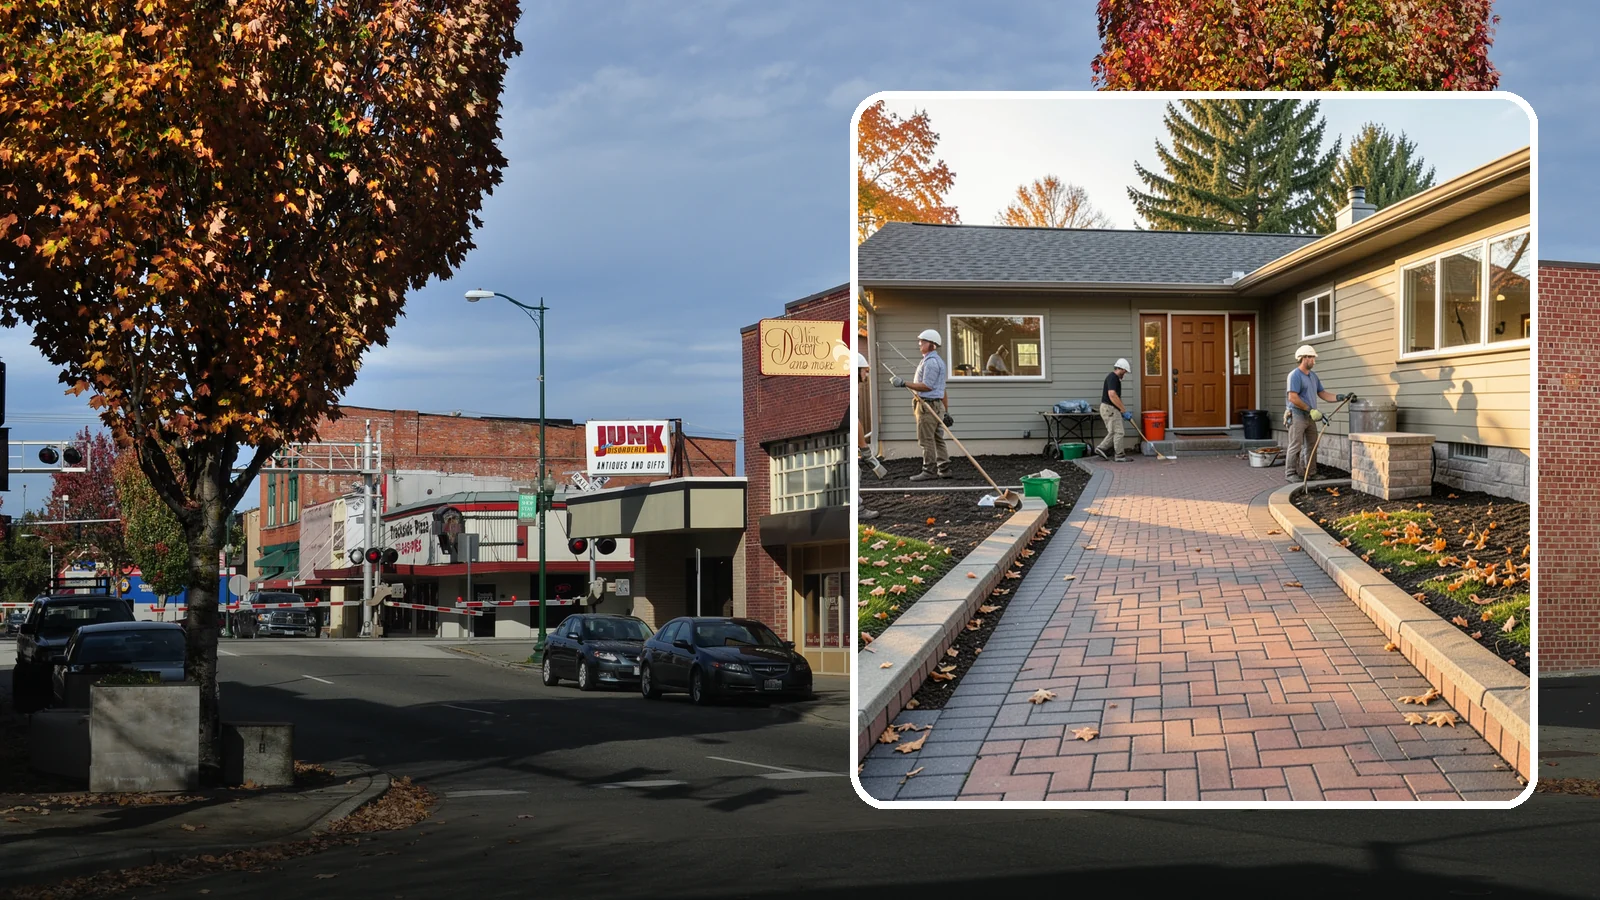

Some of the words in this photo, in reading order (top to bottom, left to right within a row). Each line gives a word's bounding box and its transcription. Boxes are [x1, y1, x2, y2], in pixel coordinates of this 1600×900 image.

[595, 425, 665, 457] JUNK
[607, 446, 646, 454] DISORDERLY
[597, 461, 628, 470] ANTIQUES
[631, 461, 644, 470] AND
[647, 460, 665, 469] GIFTS
[352, 498, 365, 511] CRO
[390, 521, 413, 540] Trackside
[414, 519, 429, 535] Pizza
